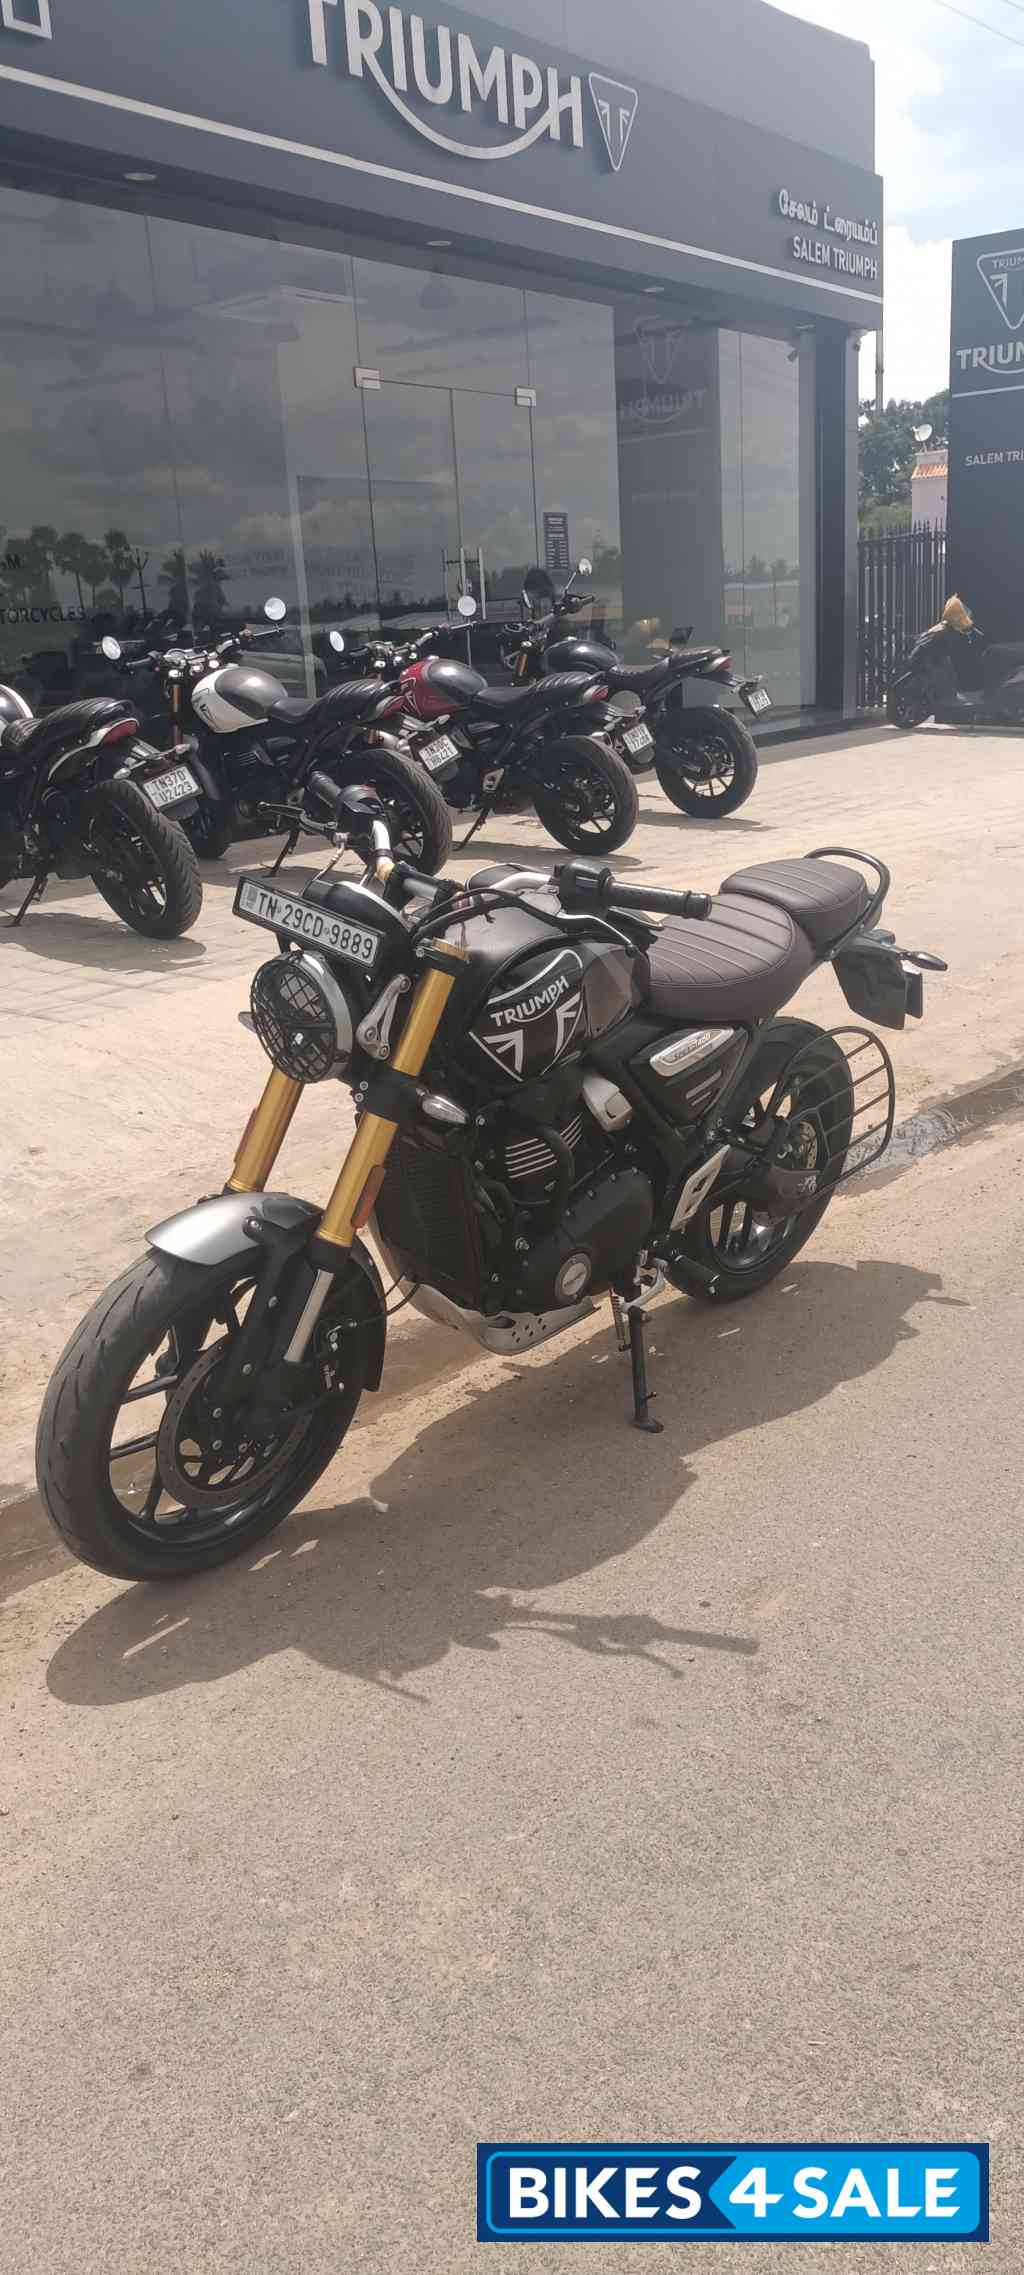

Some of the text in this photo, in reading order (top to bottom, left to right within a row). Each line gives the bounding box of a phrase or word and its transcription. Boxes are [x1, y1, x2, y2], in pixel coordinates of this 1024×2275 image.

[307, 0, 585, 159] TRIUMPH
[793, 235, 878, 280] SALEM TRIUMPH
[964, 451, 1004, 466] SALEM
[490, 976, 570, 1027] TRIUMPH
